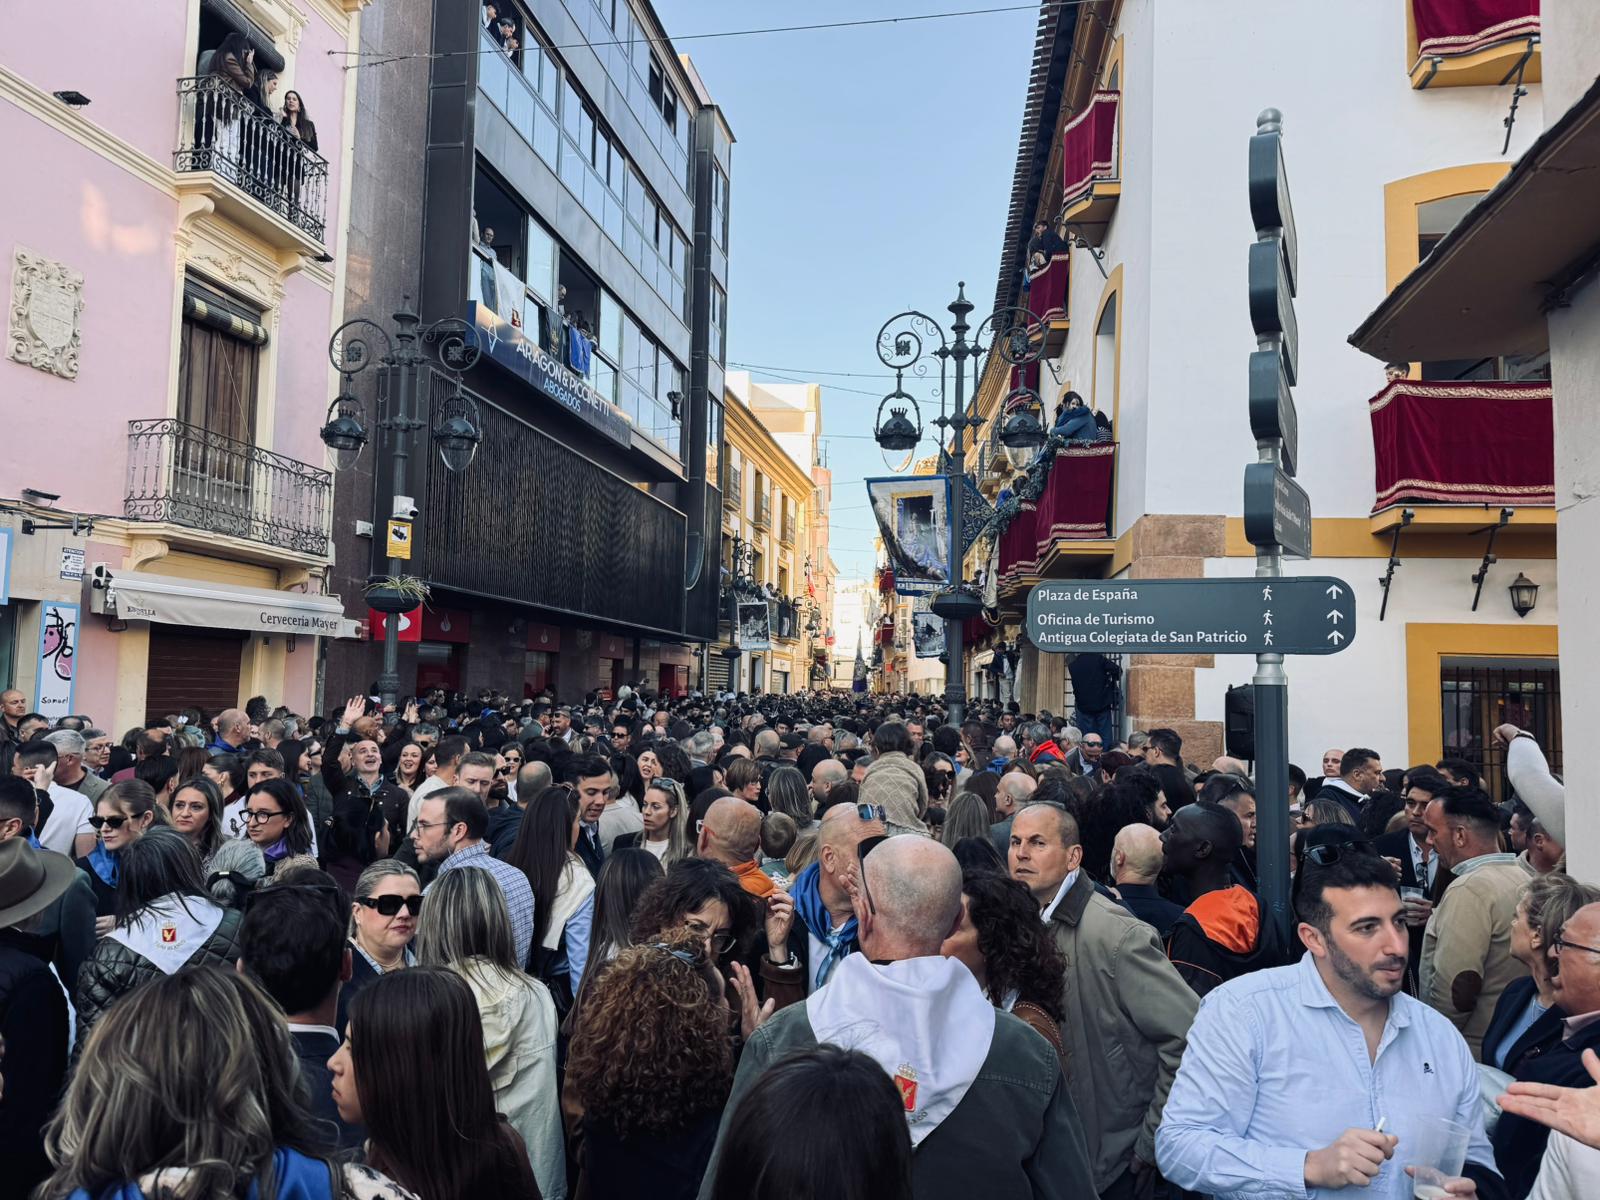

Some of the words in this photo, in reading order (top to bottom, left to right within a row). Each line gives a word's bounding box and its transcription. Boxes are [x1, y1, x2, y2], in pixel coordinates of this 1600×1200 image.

[516, 339, 561, 383] ARAGON
[543, 378, 581, 413] ABOGADOS
[1038, 589, 1071, 601] Plaza
[1074, 589, 1089, 600] de
[1092, 588, 1138, 603] España
[311, 617, 338, 631] Mayer
[1037, 613, 1082, 626] Oficina
[1084, 613, 1100, 625] de
[1102, 613, 1155, 625] Turismo
[1038, 631, 1087, 646] Antigua
[1089, 631, 1149, 646] Colegiata
[1151, 631, 1167, 643] de
[1169, 631, 1193, 643] San
[1196, 630, 1248, 643] Patricio
